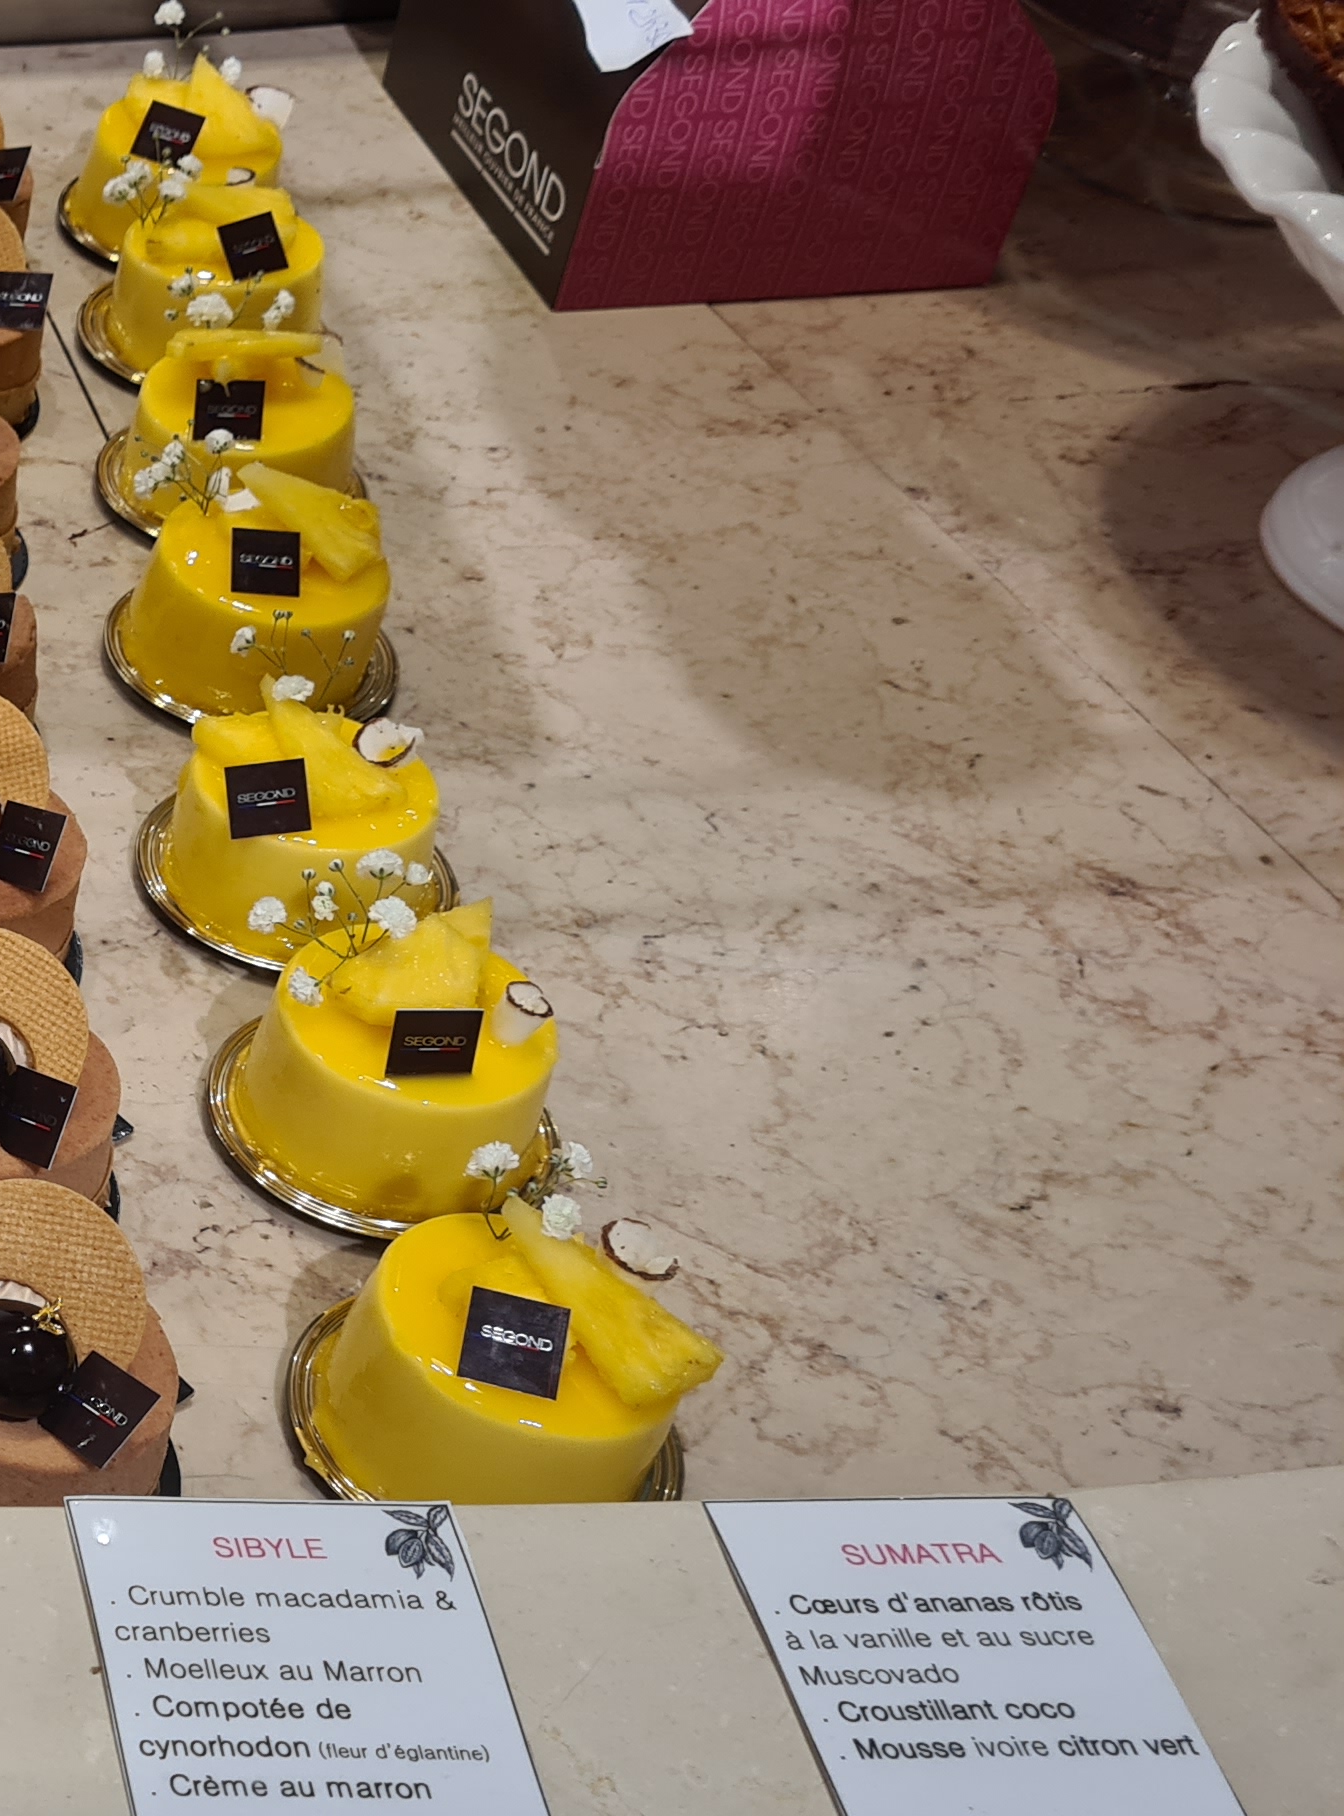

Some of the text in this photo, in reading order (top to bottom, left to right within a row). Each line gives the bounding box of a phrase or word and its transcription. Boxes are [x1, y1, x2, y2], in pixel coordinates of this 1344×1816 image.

[656, 54, 707, 187] SEGOND
[747, 48, 800, 183] SEGOND
[458, 72, 565, 222] SEGOND
[237, 787, 296, 804] SEGOND
[403, 1034, 467, 1047] SEGOND
[480, 1324, 553, 1353] SEGOND
[212, 1536, 329, 1561] SIBYLE
[841, 1542, 1003, 1567] SUMATRA
[127, 1585, 457, 1611] Crumble macadamia &
[788, 1591, 1084, 1616] Cœurs d'ananas rôtis
[114, 1622, 271, 1644] cranberries
[785, 1627, 1096, 1650] à la vanille et au sucre
[143, 1657, 423, 1684] Moelleux au Marron
[797, 1663, 960, 1687] Muscovado
[152, 1695, 352, 1722] Compotée de
[837, 1699, 1076, 1724] Croustillant coco
[138, 1735, 491, 1764] cynorhodon (fleur d'églantine)
[852, 1734, 1201, 1760] Mousse ivoire citron vert
[169, 1773, 432, 1800] Crème au marron
